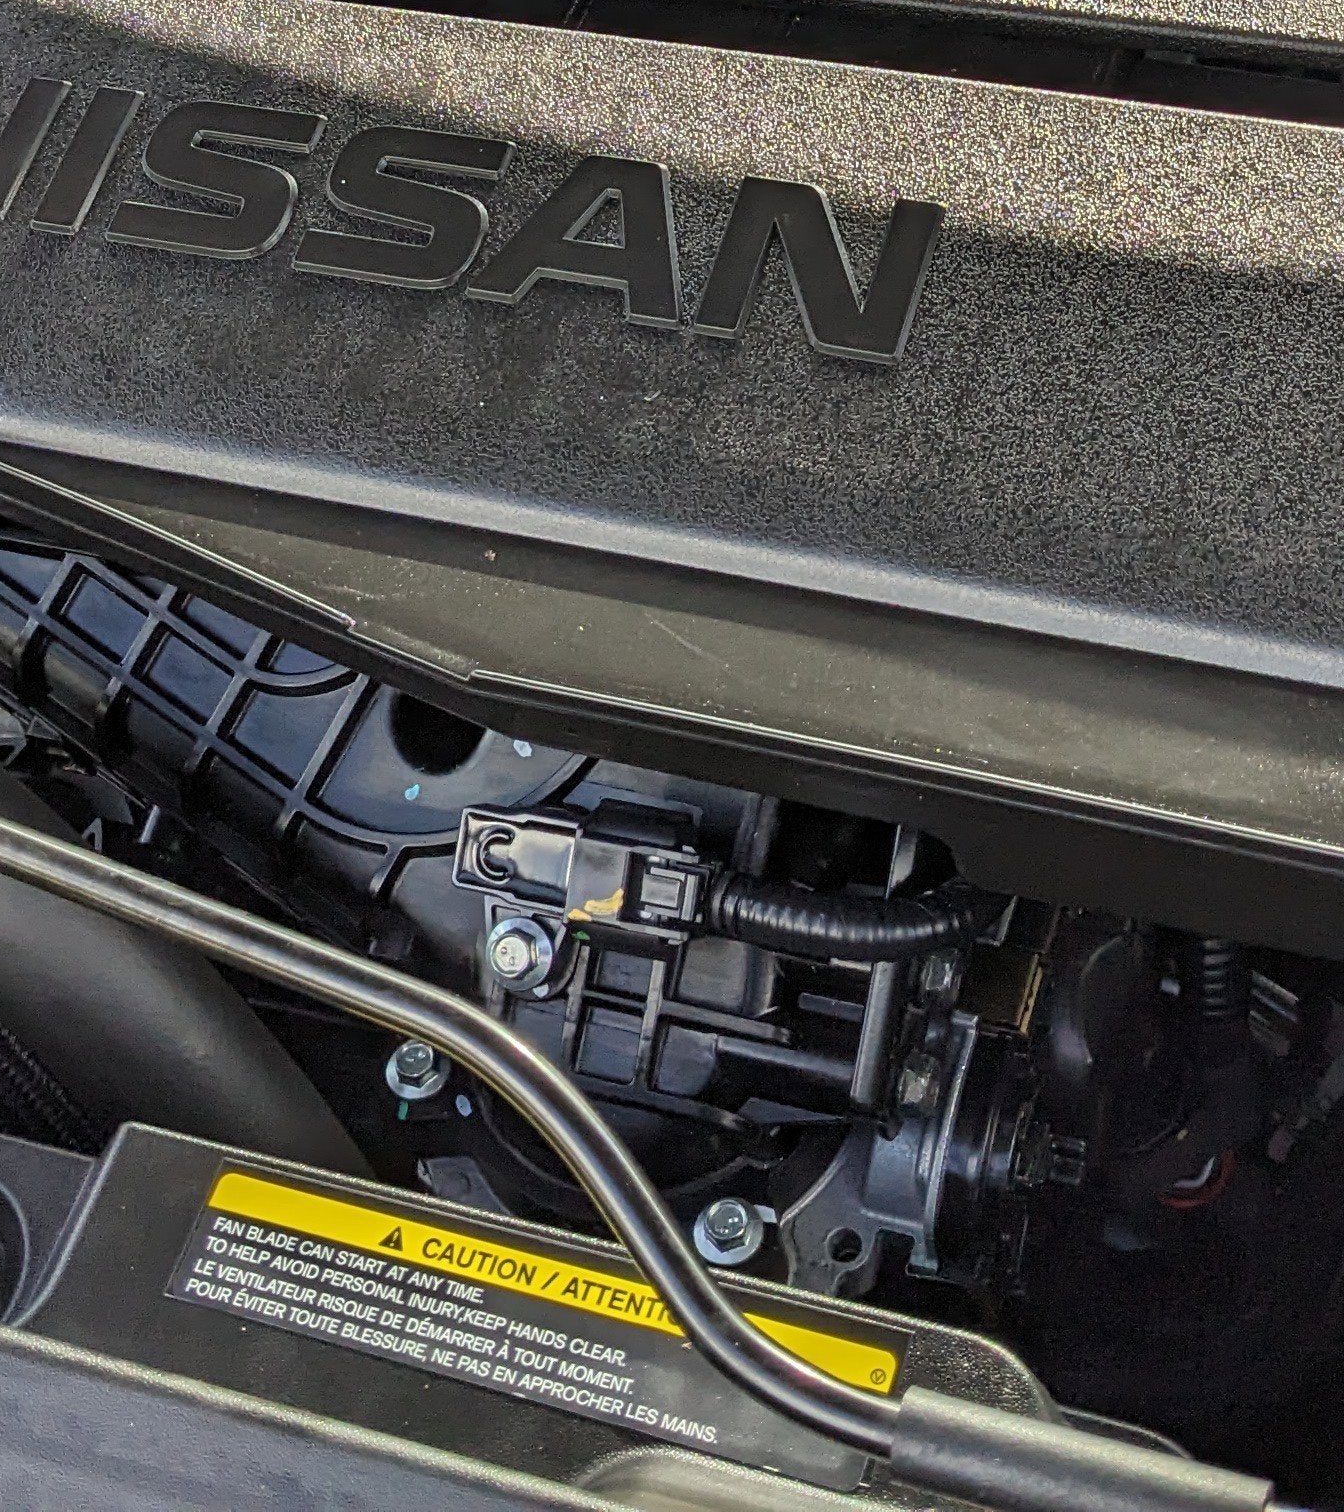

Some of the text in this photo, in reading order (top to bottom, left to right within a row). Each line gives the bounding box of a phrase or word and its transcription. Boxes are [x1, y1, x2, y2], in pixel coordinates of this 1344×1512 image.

[205, 1235, 228, 1254] TO
[228, 1244, 271, 1266] HELP
[270, 1256, 321, 1279] AVOID
[321, 1268, 405, 1305] PERSONAL
[507, 1321, 568, 1351] HANDS
[569, 1337, 627, 1367] CLEAR.
[212, 1216, 485, 1304] FAN BLADE CAN START AT ANY TIME.
[421, 1238, 677, 1327] CAUTION / ATTENTI
[185, 1278, 718, 1445] POUR ÉVITER TOUTE BLESSURE, NE PAS EN APPROCHER LES MAINS.
[193, 1258, 635, 1396] LE VENTILATEUR RISQUE DE DÉMARRER À TOUT MOMENT.
